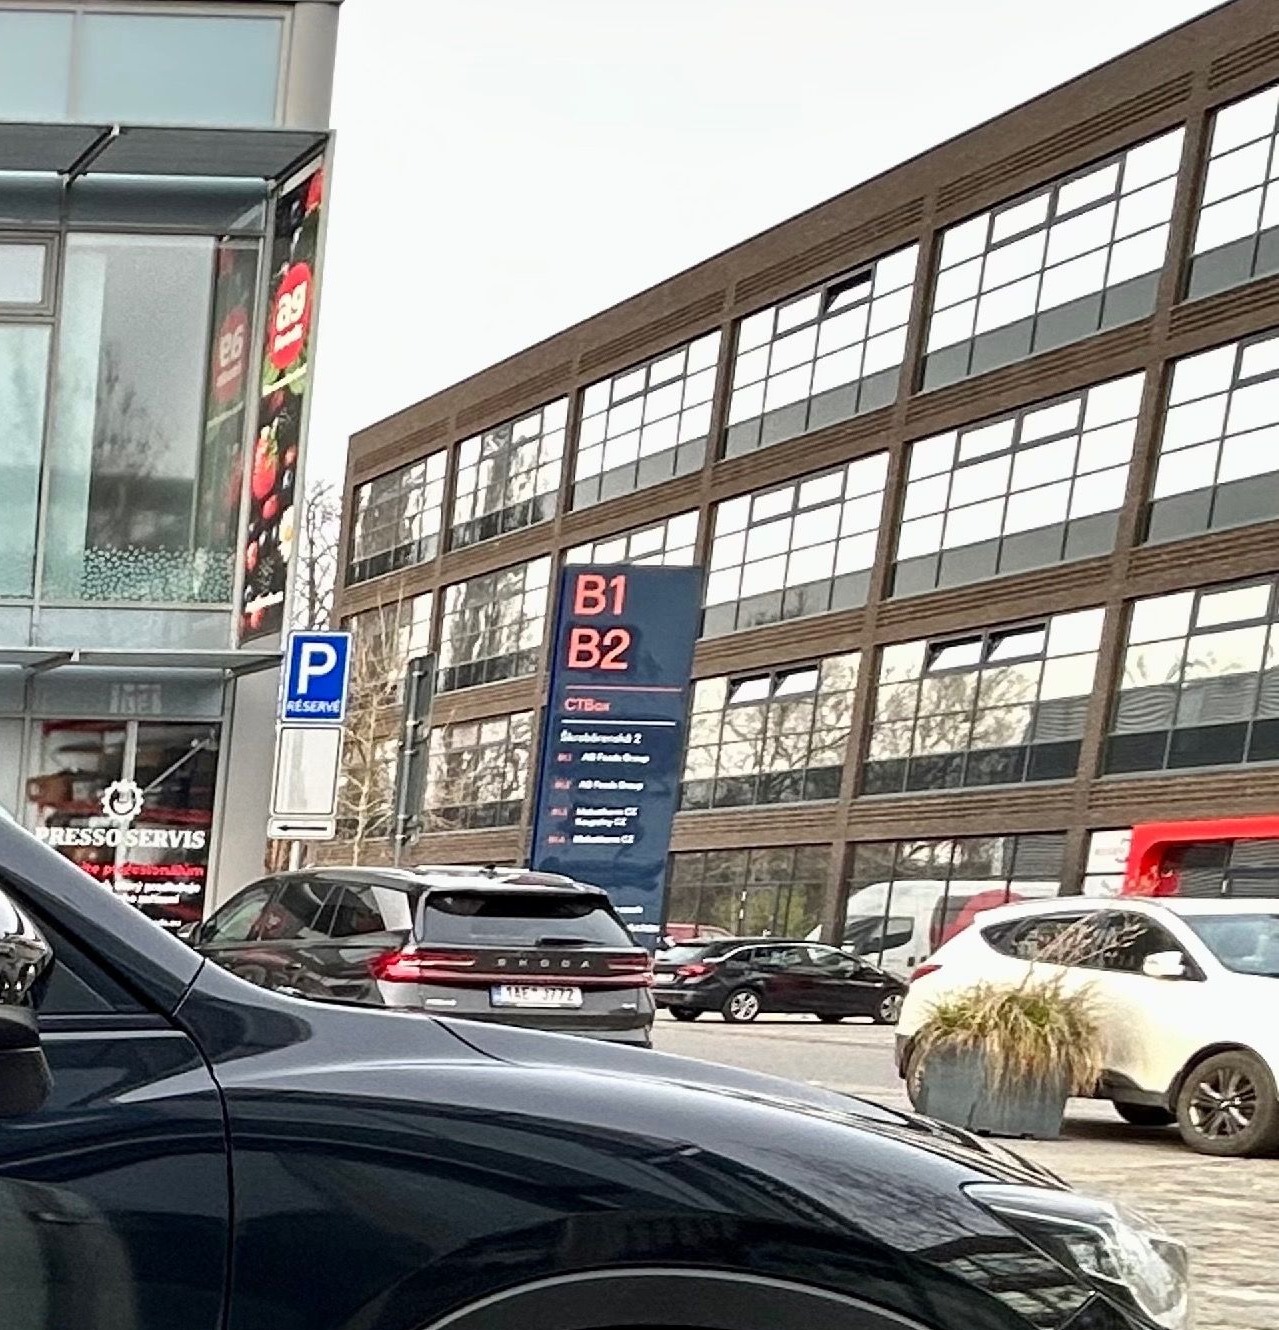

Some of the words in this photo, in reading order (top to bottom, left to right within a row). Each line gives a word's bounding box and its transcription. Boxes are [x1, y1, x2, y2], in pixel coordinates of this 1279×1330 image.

[275, 280, 307, 332] ag
[574, 574, 626, 616] B1
[296, 643, 337, 694] P
[568, 628, 630, 669] B2
[125, 828, 206, 850] SERVIS
